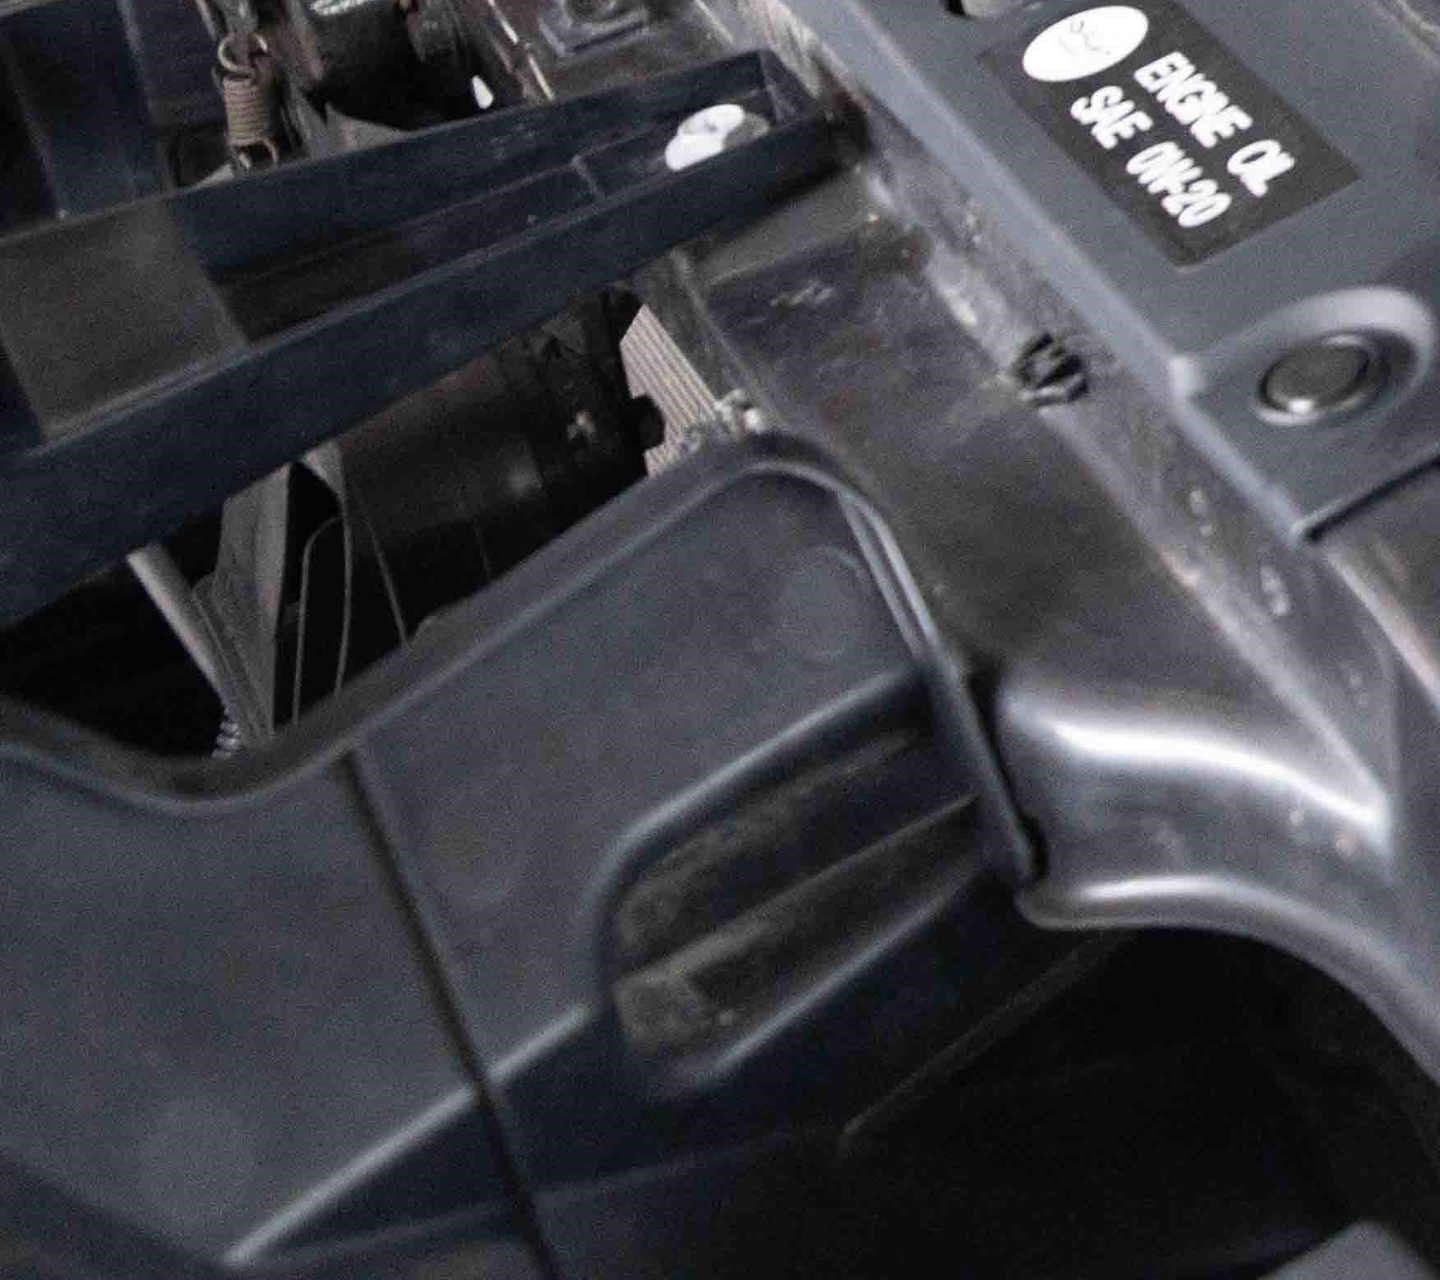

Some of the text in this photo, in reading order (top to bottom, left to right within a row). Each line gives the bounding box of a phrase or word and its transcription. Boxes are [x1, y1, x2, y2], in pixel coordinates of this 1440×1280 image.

[1070, 85, 1155, 150] SAE
[1133, 51, 1298, 198] ENGINE OIL
